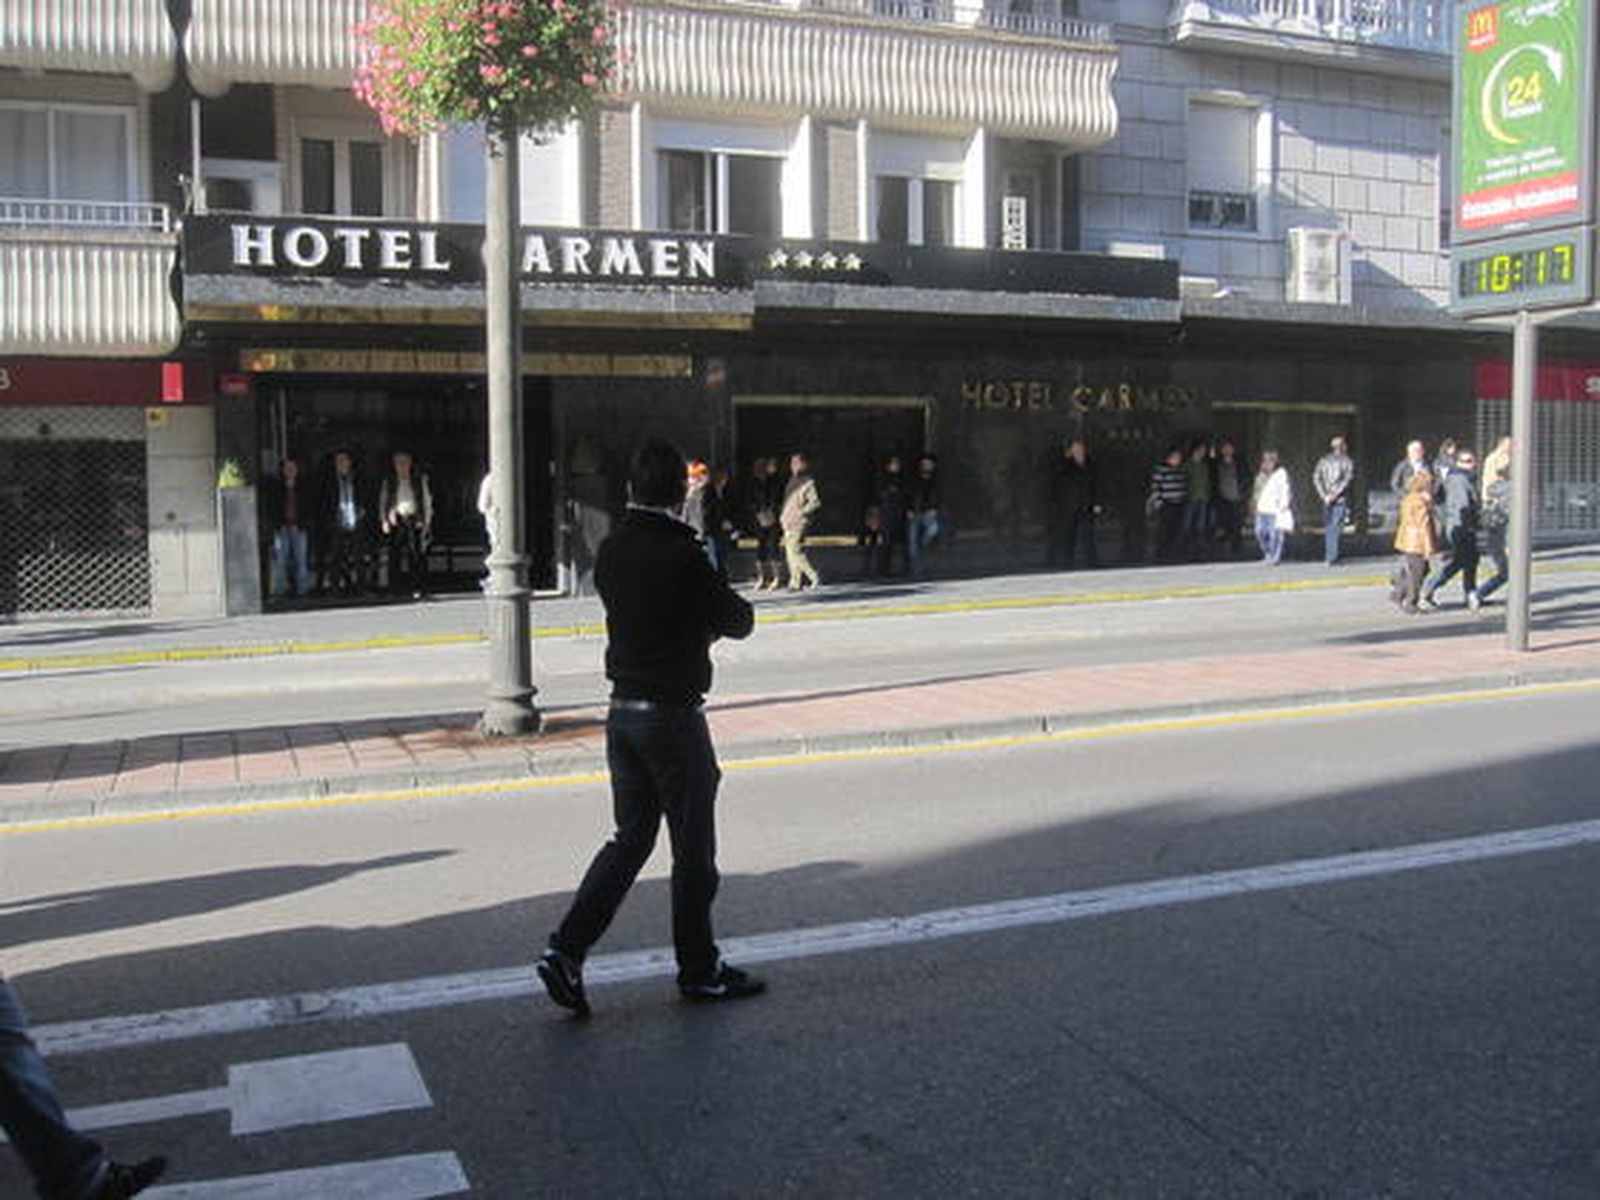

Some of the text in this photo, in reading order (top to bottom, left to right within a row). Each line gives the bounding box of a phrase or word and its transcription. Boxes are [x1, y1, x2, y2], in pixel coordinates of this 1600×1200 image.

[1506, 70, 1542, 107] 24
[230, 223, 715, 279] HOTEL ARMEN
[1480, 243, 1572, 293] 10:17
[960, 380, 1053, 411] HOTEL
